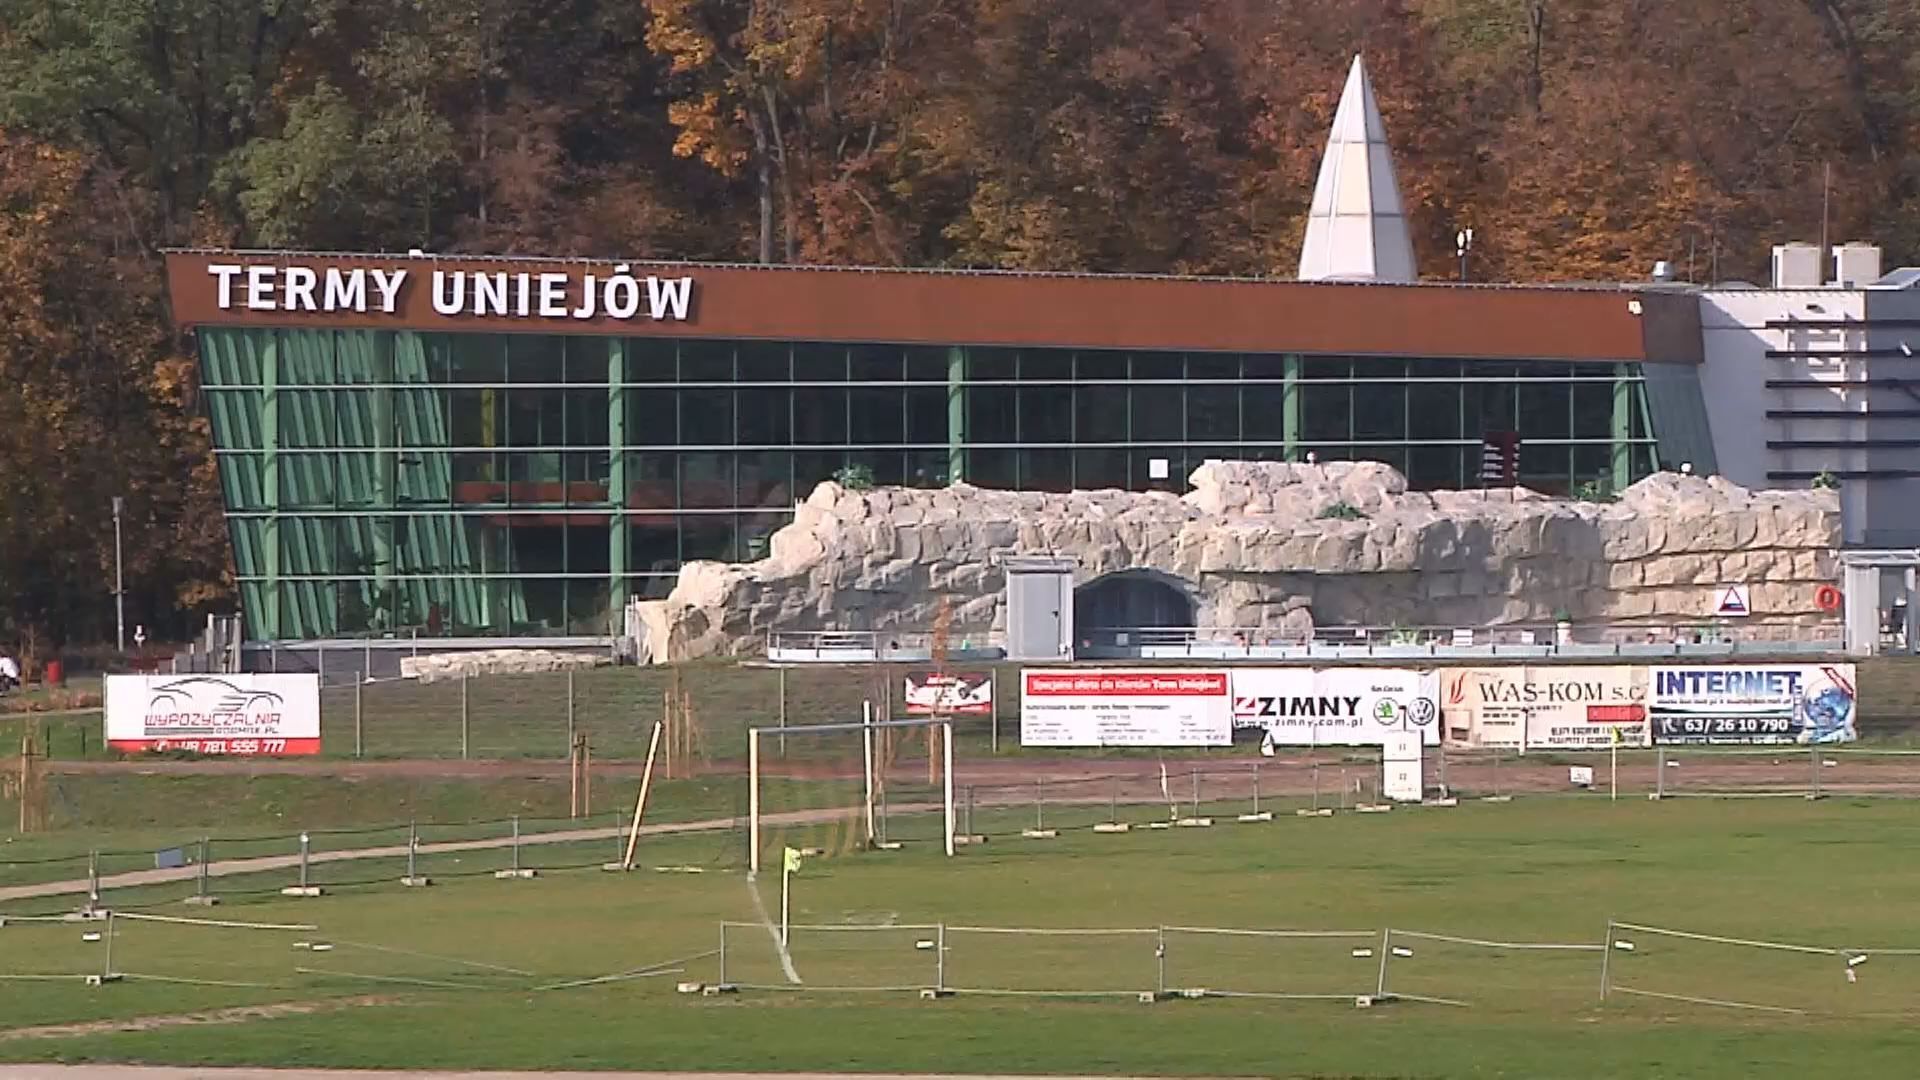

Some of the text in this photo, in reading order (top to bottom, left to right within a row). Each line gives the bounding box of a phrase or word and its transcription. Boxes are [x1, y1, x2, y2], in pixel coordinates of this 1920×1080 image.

[208, 264, 693, 321] TERMY UNIEJÓW
[1479, 680, 1603, 702] WAS-KOM
[1656, 671, 1802, 697] INTERNET
[1258, 697, 1362, 716] ZIMNY
[1684, 718, 1788, 733] 63/ 26 10 790
[203, 740, 228, 753] 781
[230, 740, 258, 753] 555
[263, 740, 287, 753] 777
